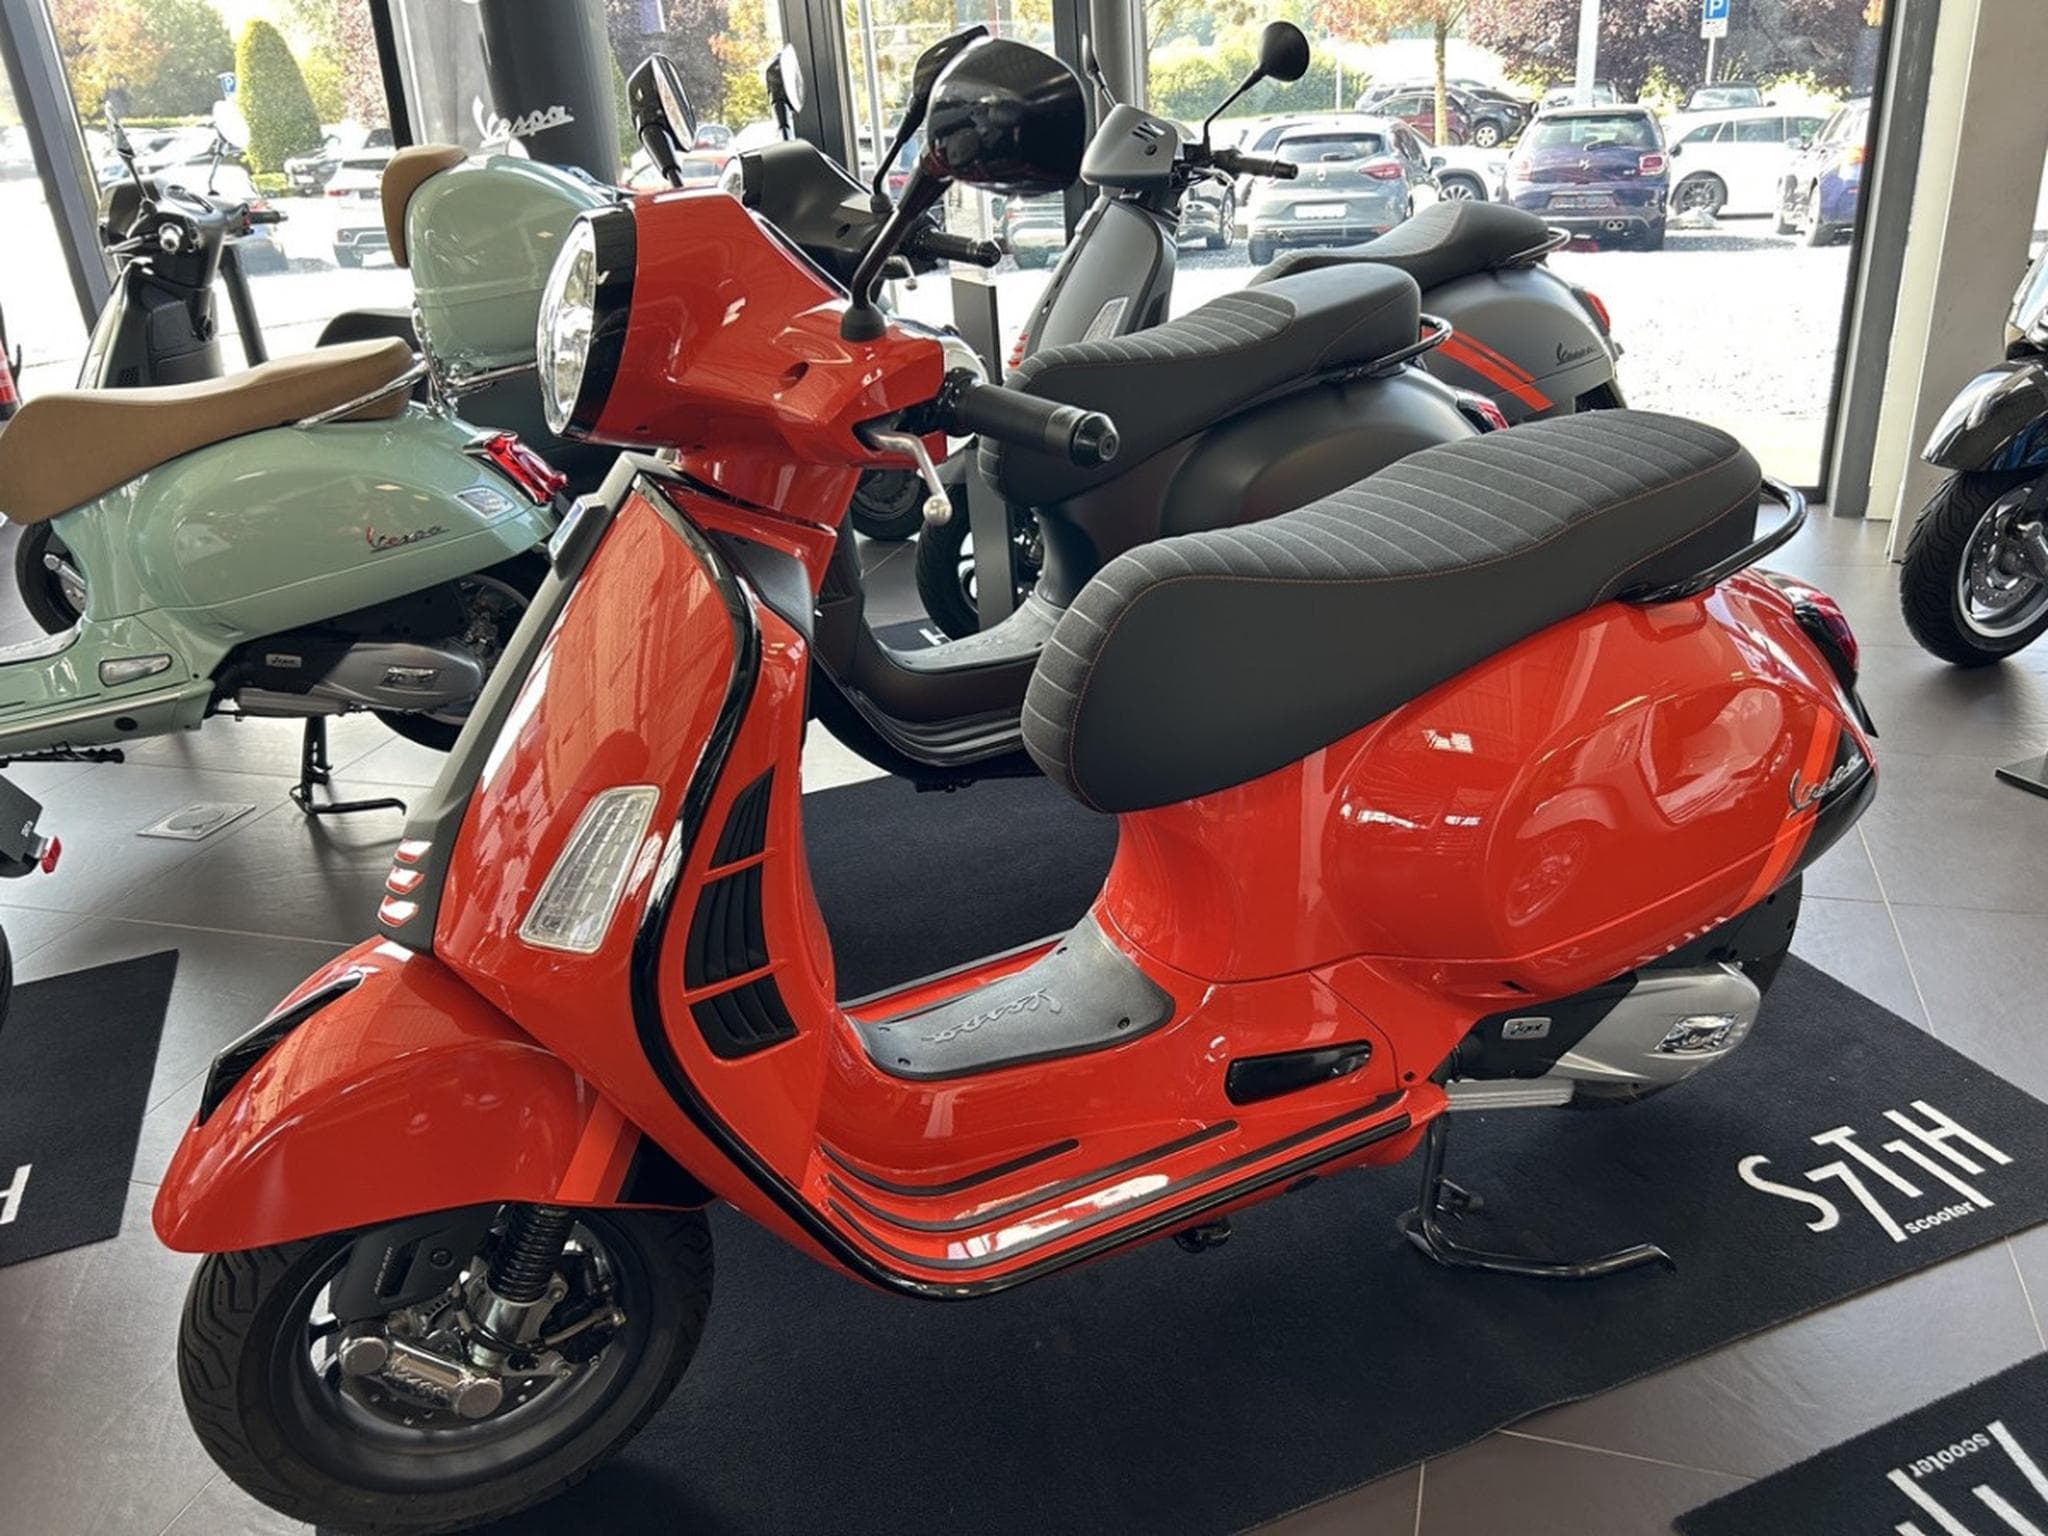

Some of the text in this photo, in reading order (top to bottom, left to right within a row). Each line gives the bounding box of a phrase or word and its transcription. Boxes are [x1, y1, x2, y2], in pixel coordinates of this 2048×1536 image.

[472, 95, 575, 148] Vespa
[365, 525, 450, 554] Vespa
[1787, 752, 1864, 820] Vespa
[920, 987, 1062, 1043] Vespa
[1904, 1199, 1976, 1234] scooter
[1908, 1432, 1991, 1478] scooter
